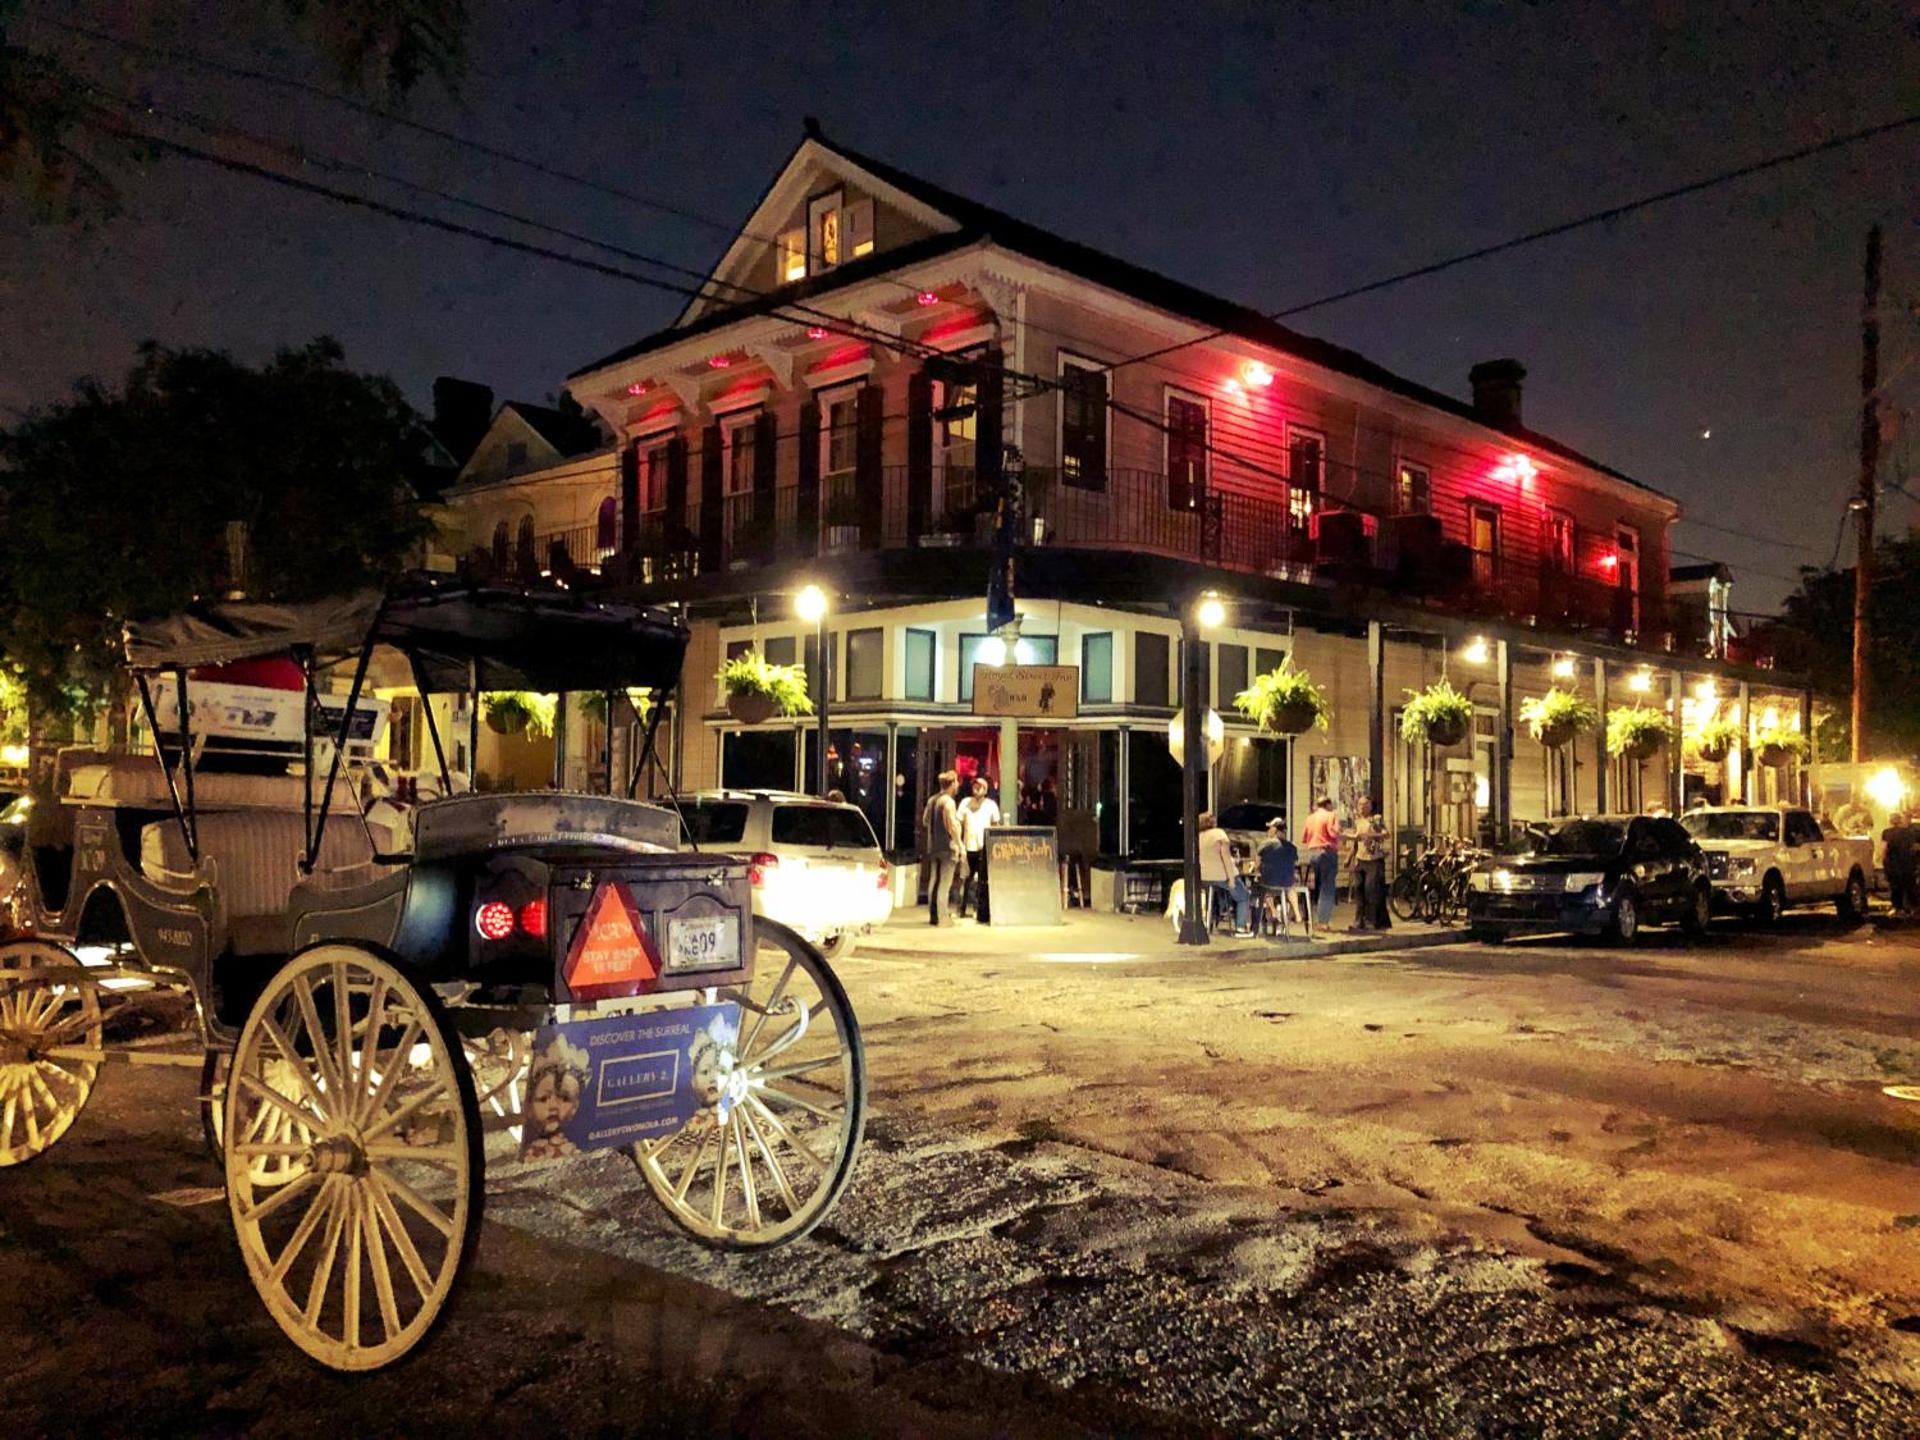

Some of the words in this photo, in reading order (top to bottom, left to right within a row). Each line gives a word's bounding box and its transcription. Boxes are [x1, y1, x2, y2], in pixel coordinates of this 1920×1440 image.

[590, 1030, 636, 1047] DISCOVER
[638, 1027, 654, 1040] THE
[655, 1023, 691, 1038] SURREAL
